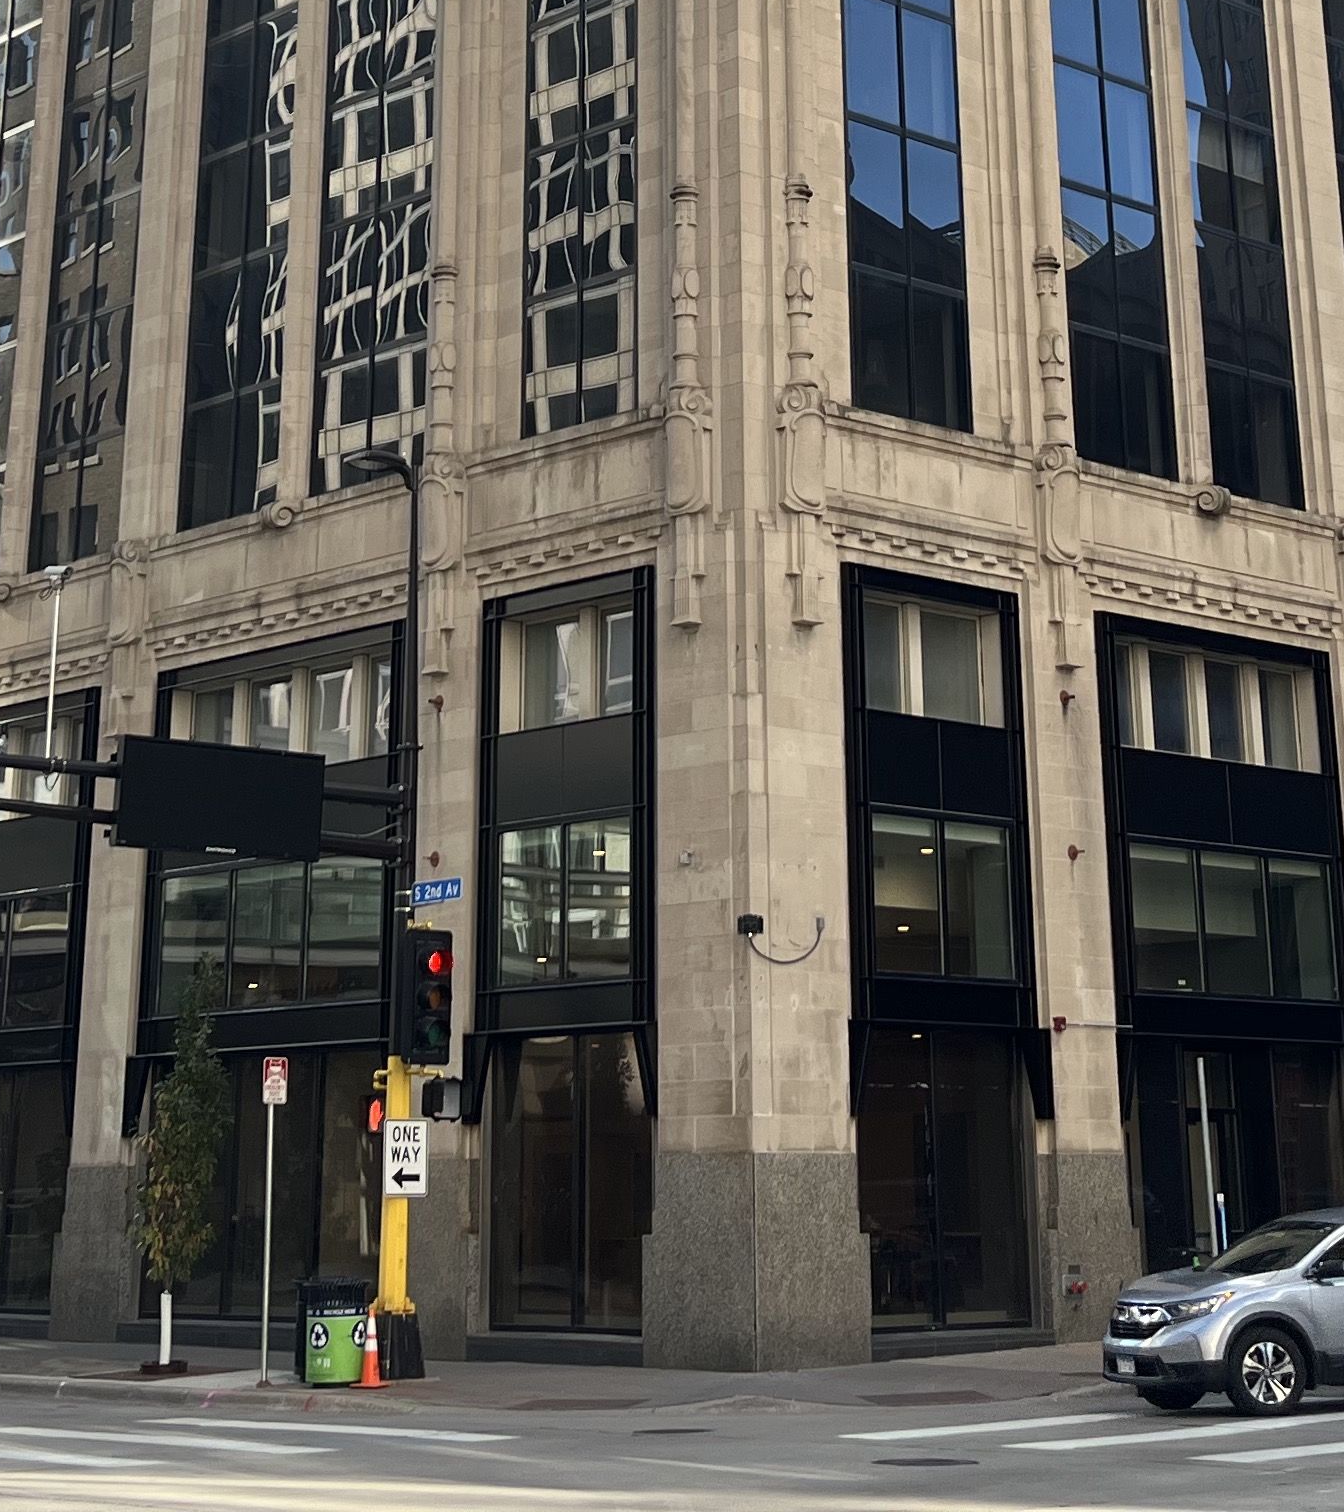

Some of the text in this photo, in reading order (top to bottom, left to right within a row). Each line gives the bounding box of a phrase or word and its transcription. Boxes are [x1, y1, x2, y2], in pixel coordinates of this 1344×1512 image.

[415, 882, 459, 901] S 2nd Av
[393, 1126, 420, 1143] ONE
[391, 1146, 421, 1163] WAY
